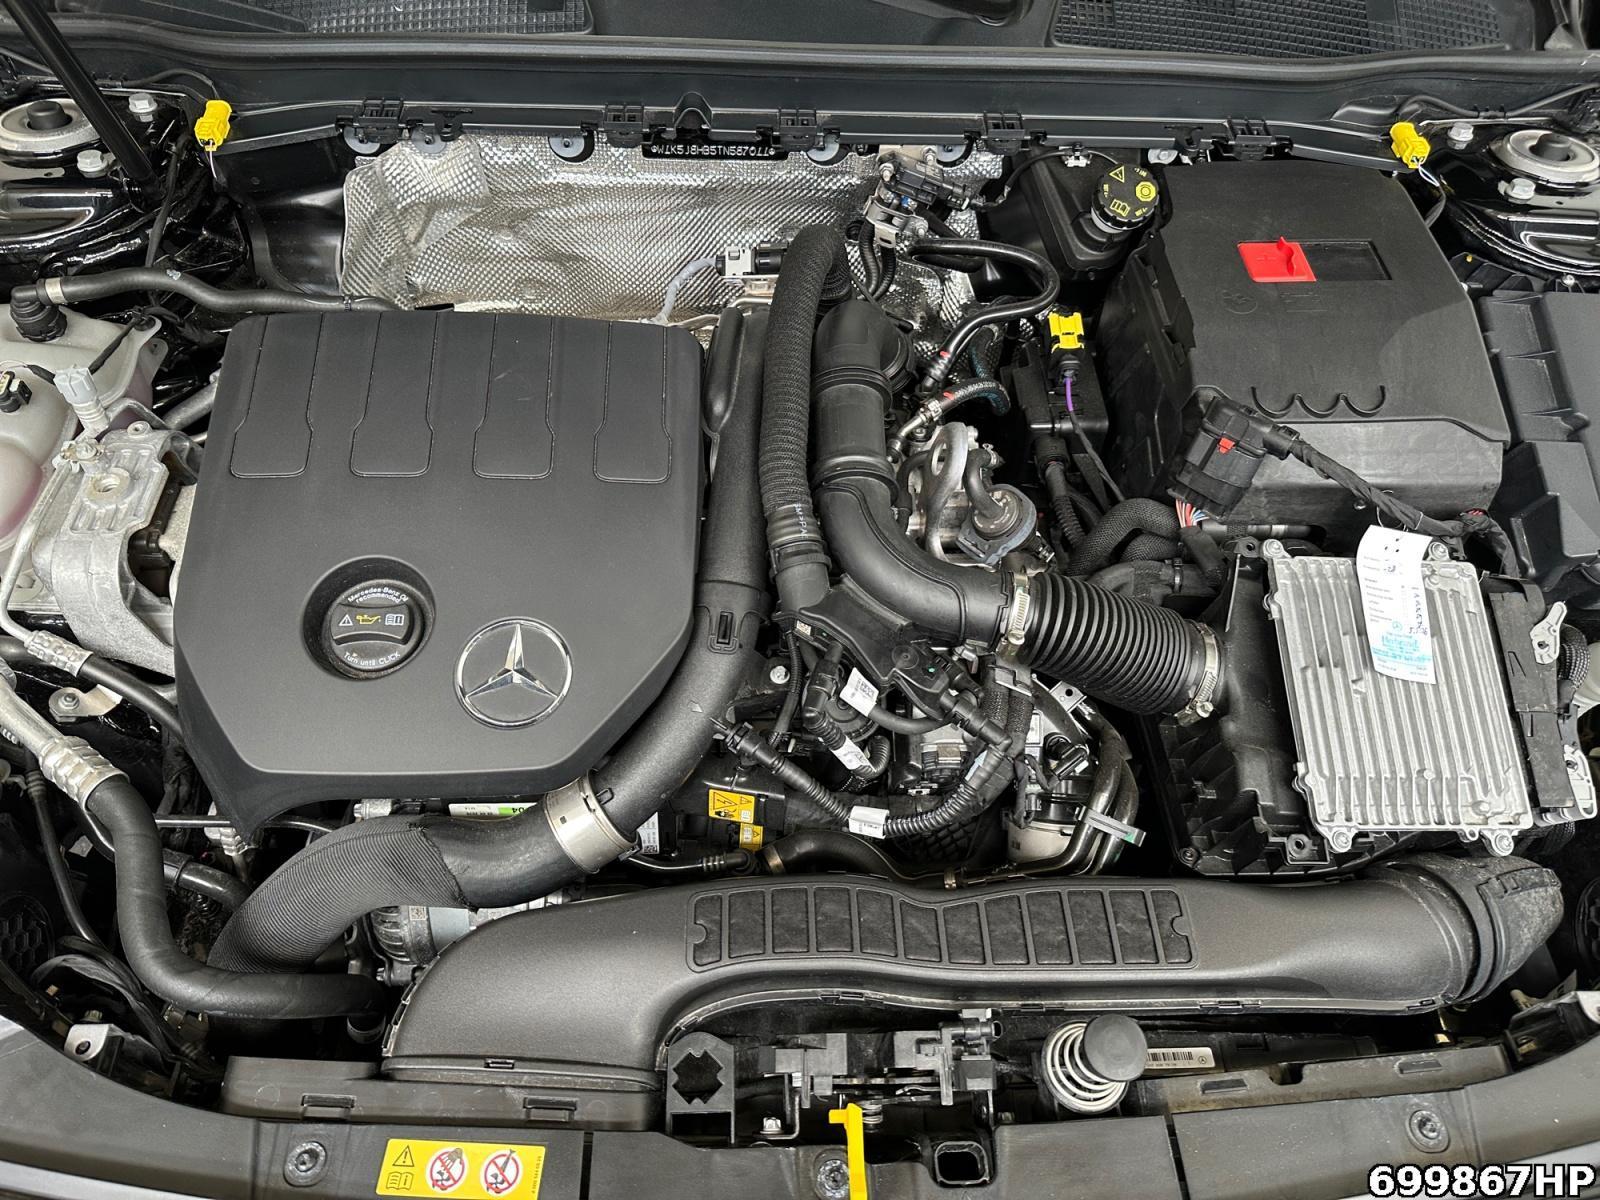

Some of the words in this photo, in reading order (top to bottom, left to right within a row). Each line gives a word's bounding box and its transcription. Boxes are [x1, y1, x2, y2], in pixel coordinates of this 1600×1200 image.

[355, 592, 401, 604] recommended
[344, 652, 358, 664] Turn
[378, 651, 401, 665] CLICK
